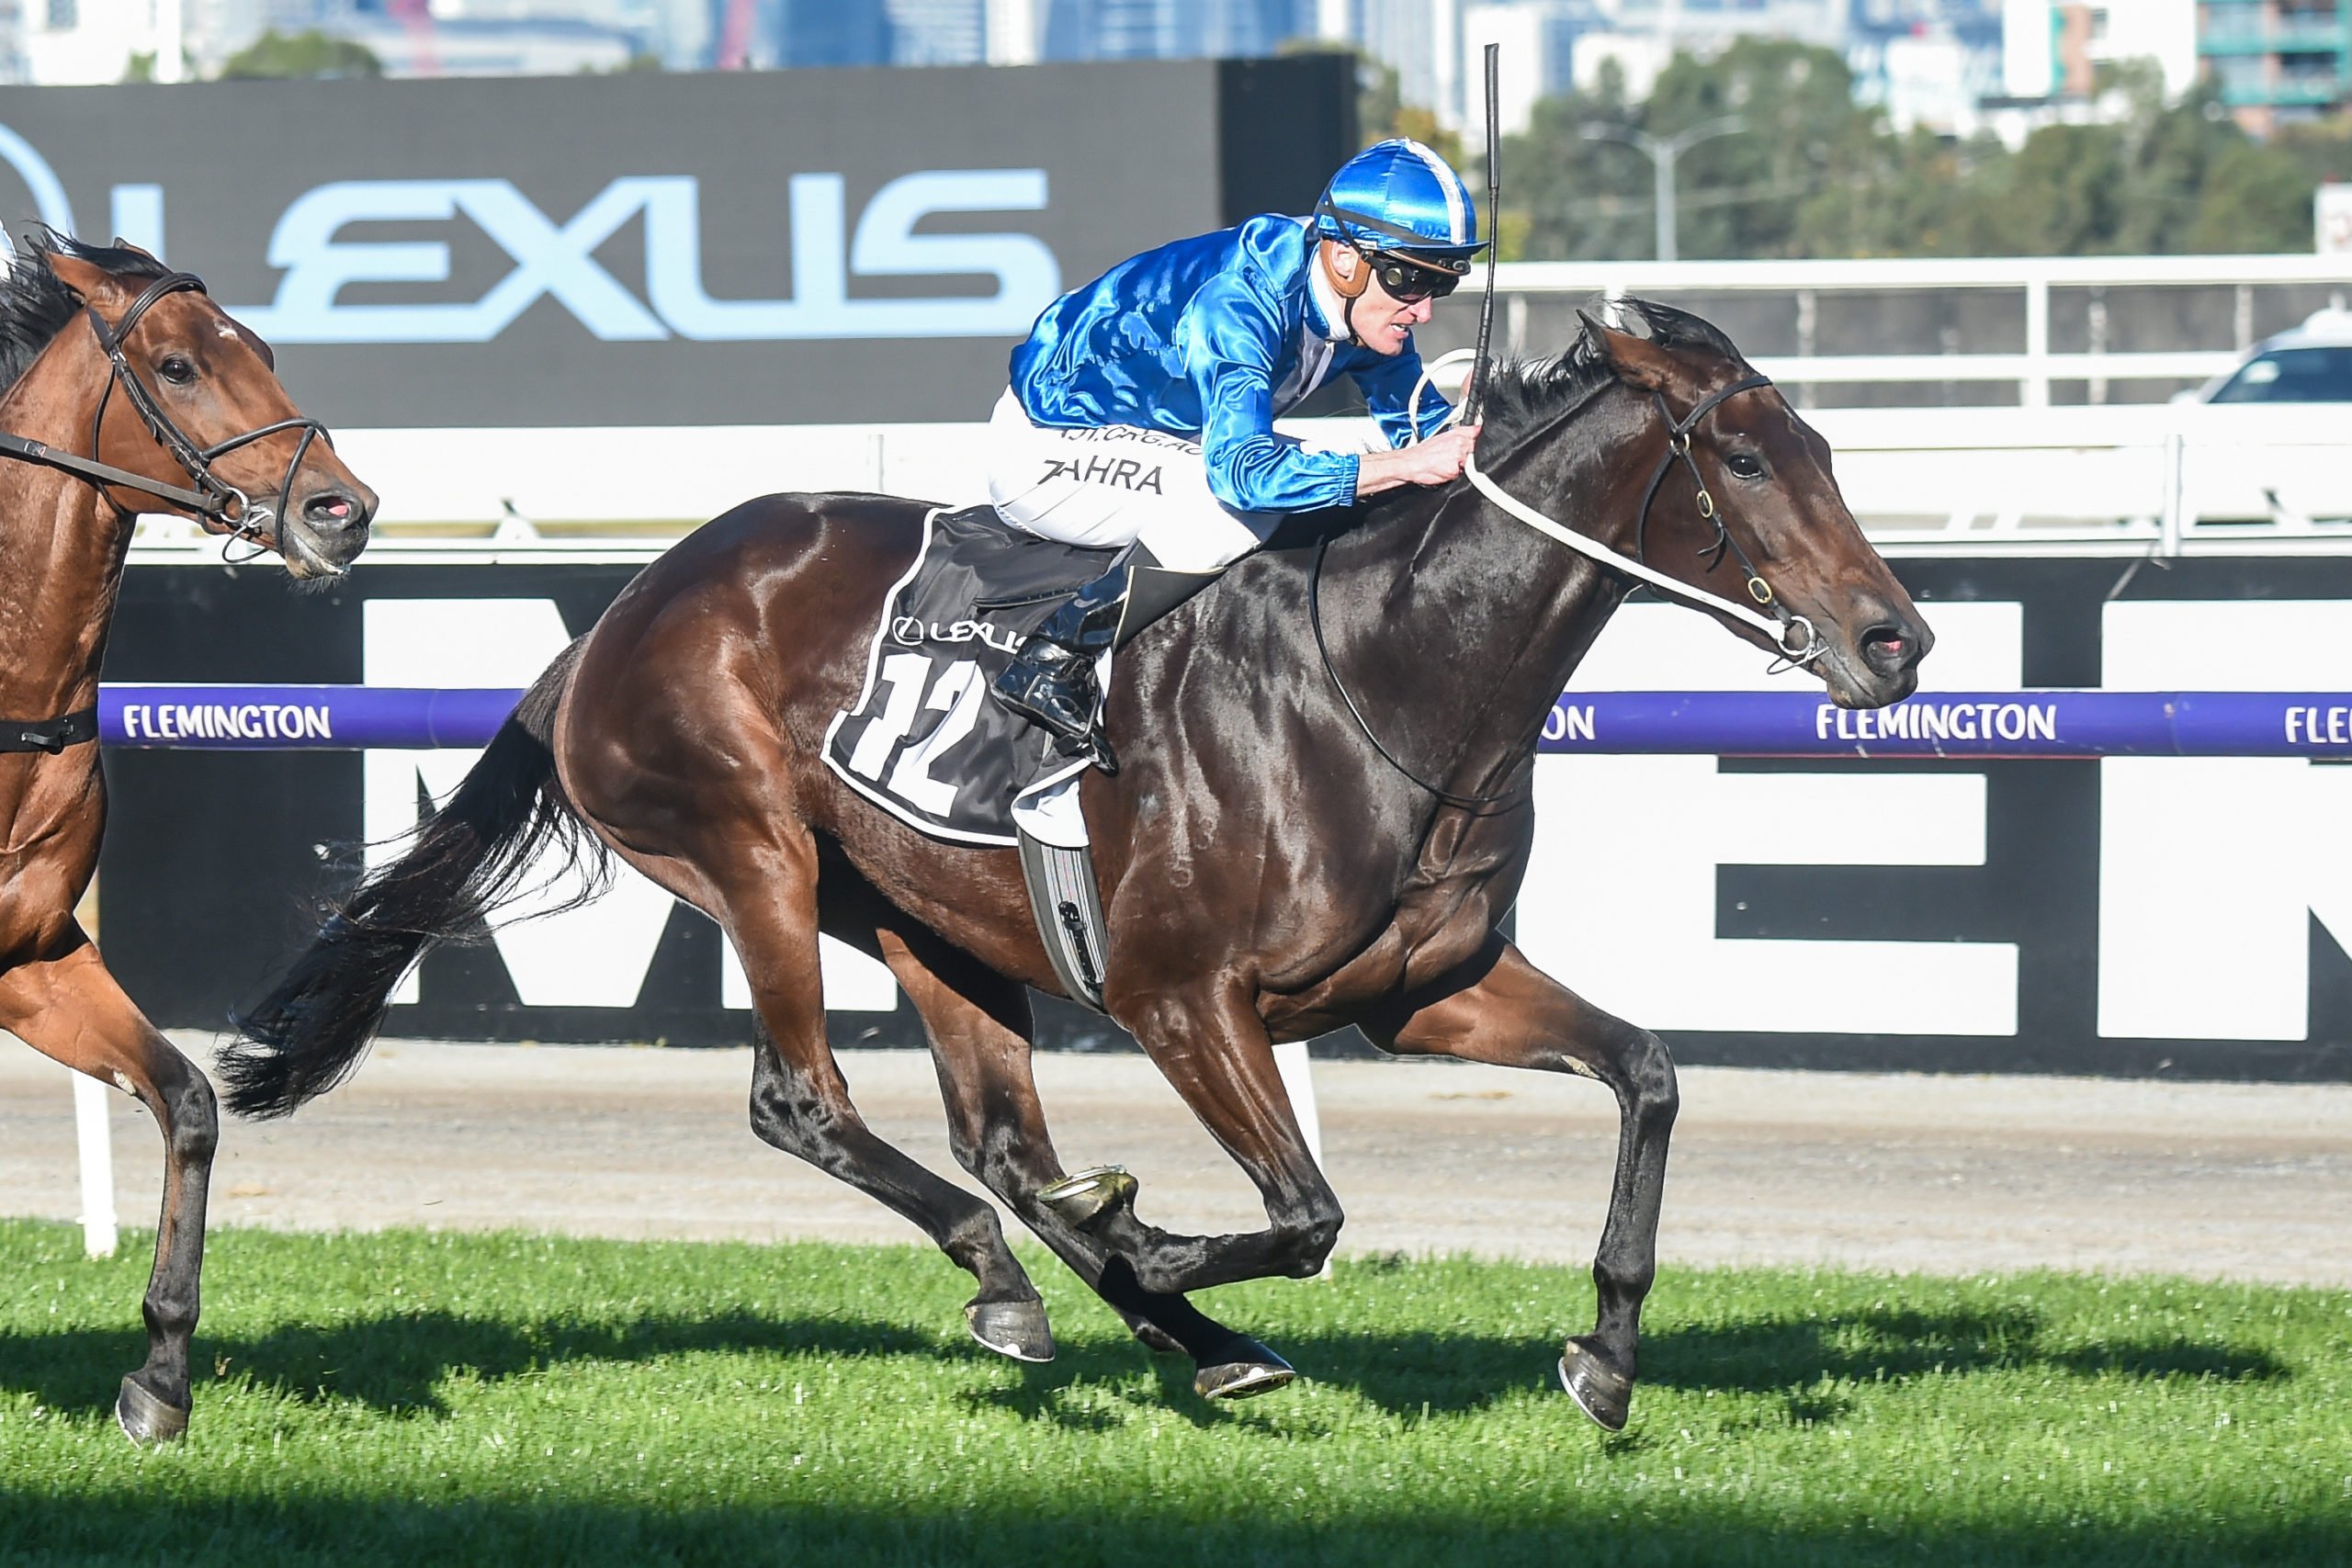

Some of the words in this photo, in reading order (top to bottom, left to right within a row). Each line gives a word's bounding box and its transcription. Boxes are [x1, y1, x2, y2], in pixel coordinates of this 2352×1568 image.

[123, 705, 332, 739] FLEMINGTON
[848, 653, 986, 818] 12
[1816, 704, 2056, 740] FLEMINGTON
[2285, 706, 2352, 743] FLE
